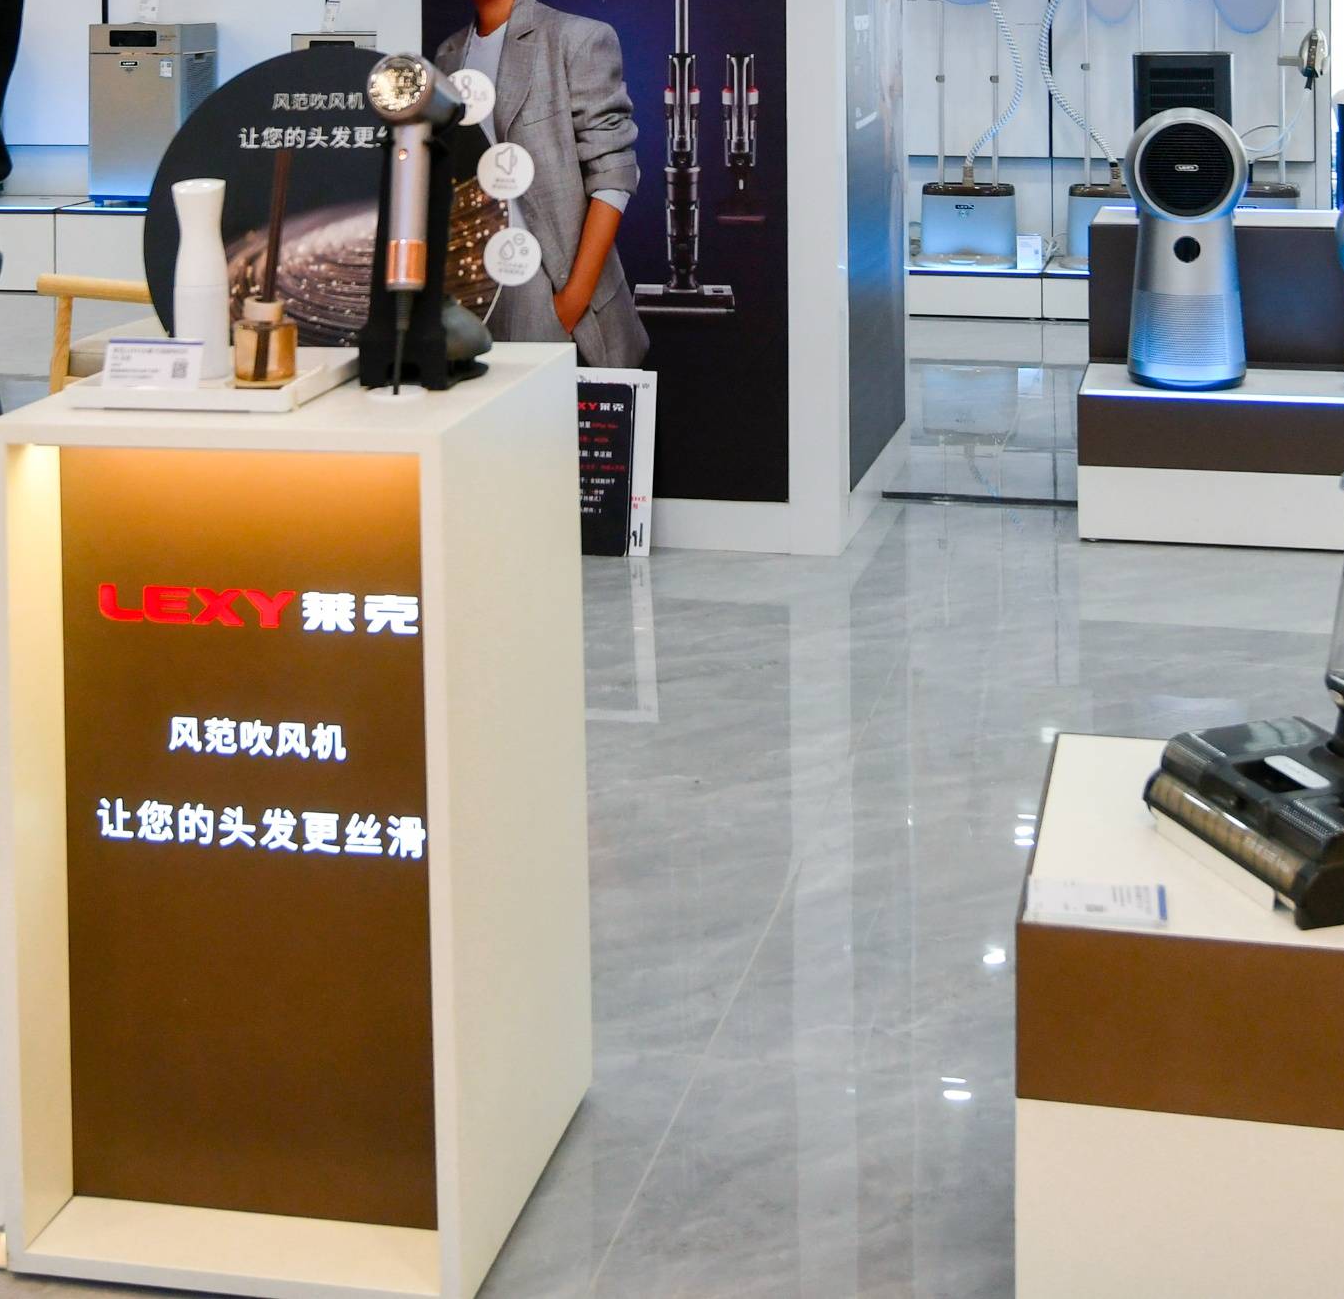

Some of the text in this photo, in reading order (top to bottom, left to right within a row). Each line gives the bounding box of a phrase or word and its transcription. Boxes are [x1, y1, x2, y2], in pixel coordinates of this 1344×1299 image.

[271, 91, 367, 111] 风范吹风机
[99, 583, 420, 634] LEXY 莱克
[167, 715, 347, 761] 风范吹风机
[97, 797, 428, 860] 让您的头发更丝滑
